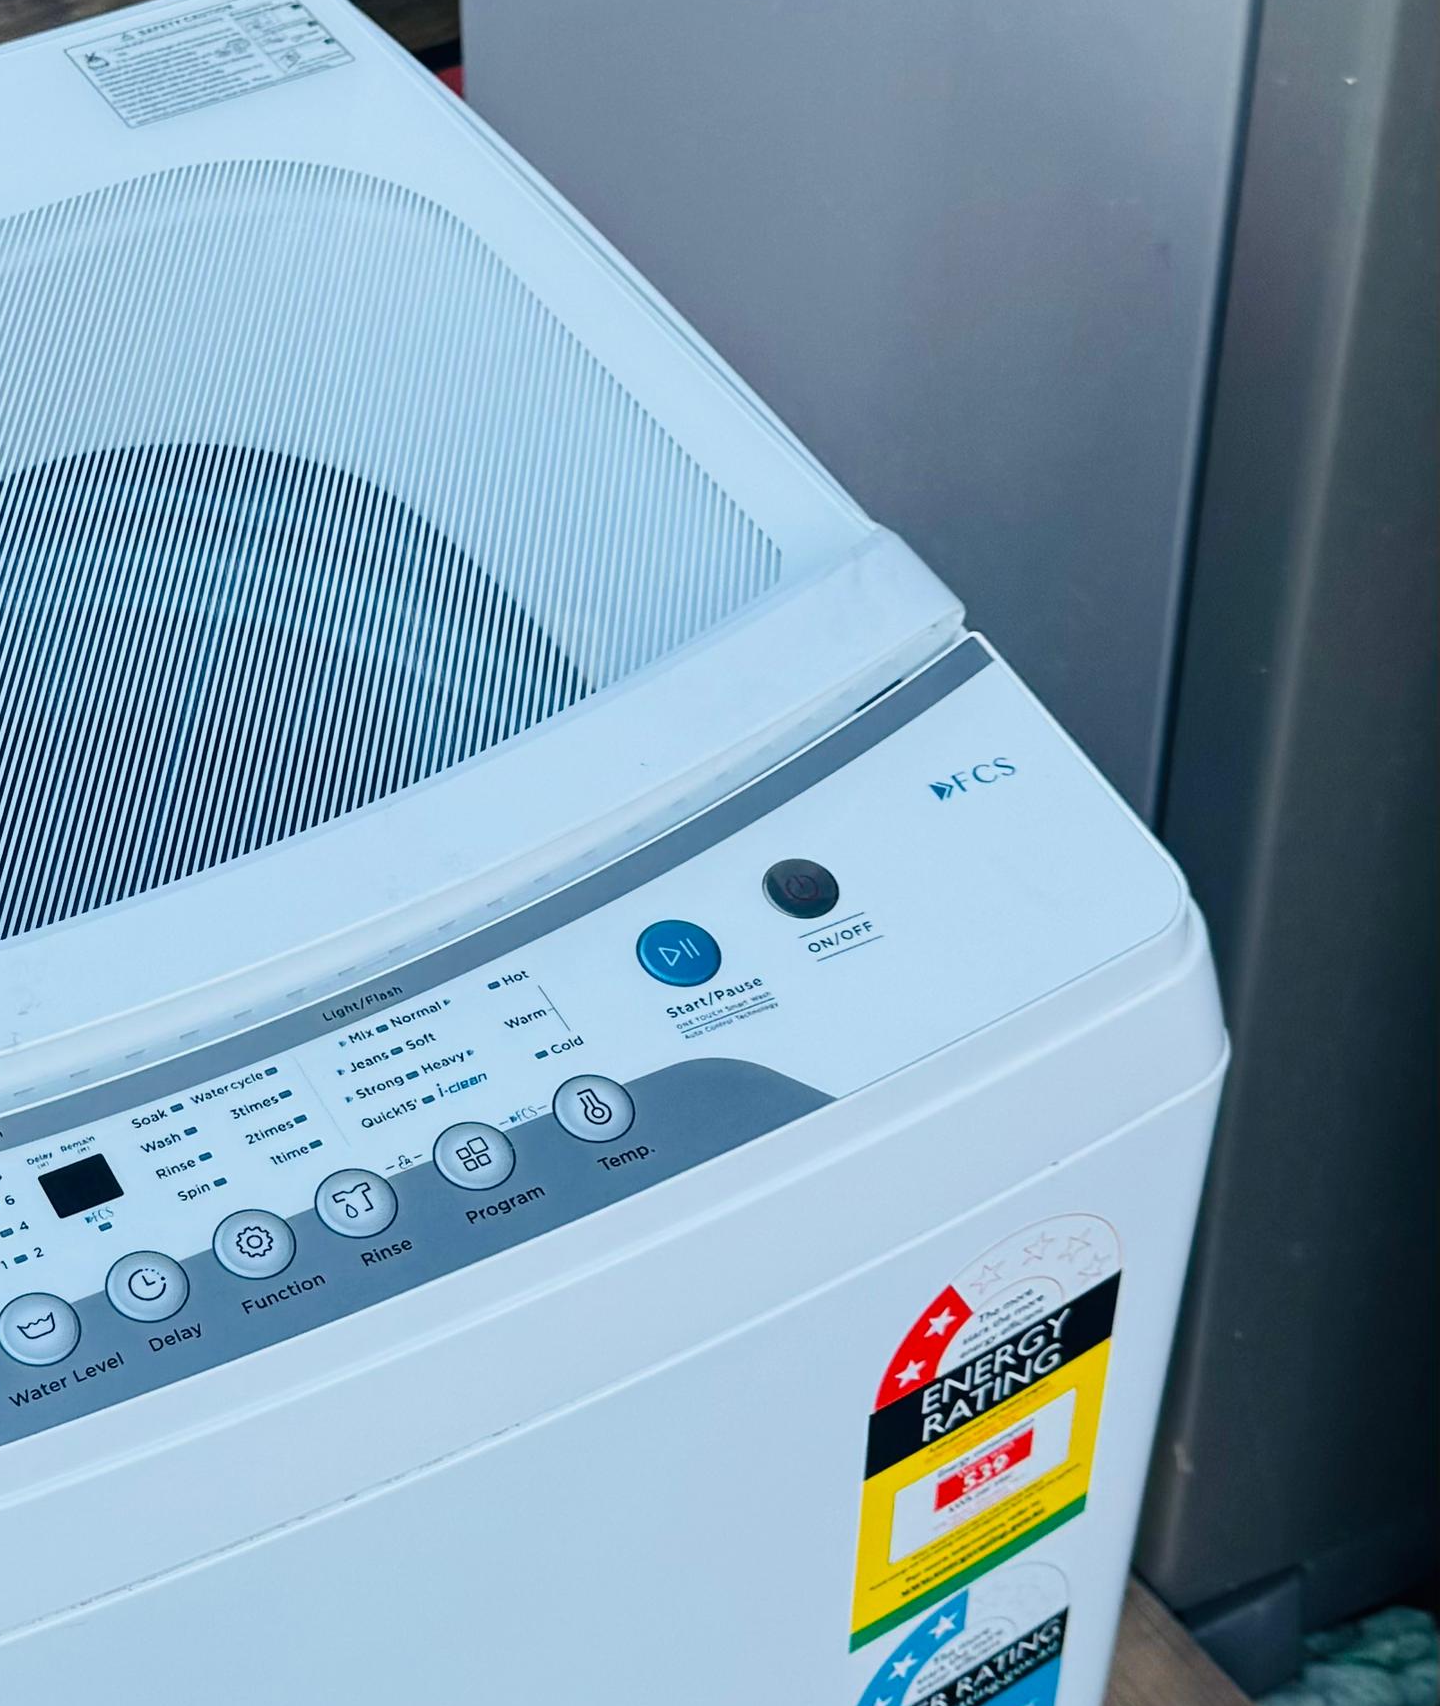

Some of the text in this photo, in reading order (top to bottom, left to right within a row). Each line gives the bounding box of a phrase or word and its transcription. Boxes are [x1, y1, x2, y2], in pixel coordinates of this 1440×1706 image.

[951, 757, 1016, 793] FCS
[808, 921, 873, 953] ON/OFF
[502, 970, 530, 986] Hot
[322, 986, 403, 1022] Light/Flash
[666, 978, 763, 1019] Start/Pause
[348, 1001, 442, 1044] Mix Normal
[504, 1008, 547, 1029] Warm
[350, 1032, 437, 1073] Jeans Soft
[550, 1035, 584, 1054] Cold
[355, 1052, 465, 1099] Strong Heavy
[131, 1109, 168, 1129] Soak
[230, 1094, 279, 1120] 3times
[140, 1133, 182, 1154] Wash
[245, 1119, 294, 1145] 2times
[155, 1157, 196, 1179] Rinse
[597, 1144, 656, 1172] Temp.
[4, 1195, 15, 1206] 6
[177, 1182, 211, 1201] Spin
[465, 1184, 547, 1225] Program
[19, 1221, 29, 1230] 4
[0, 1247, 44, 1269] 1 2
[360, 1238, 414, 1267] Rinse
[240, 1272, 327, 1315] Function
[148, 1323, 202, 1352] Delay
[921, 1308, 1072, 1415] ENERGY
[8, 1352, 125, 1407] Water Level
[921, 1343, 1063, 1443] RATING
[956, 1618, 1061, 1698] RATING
